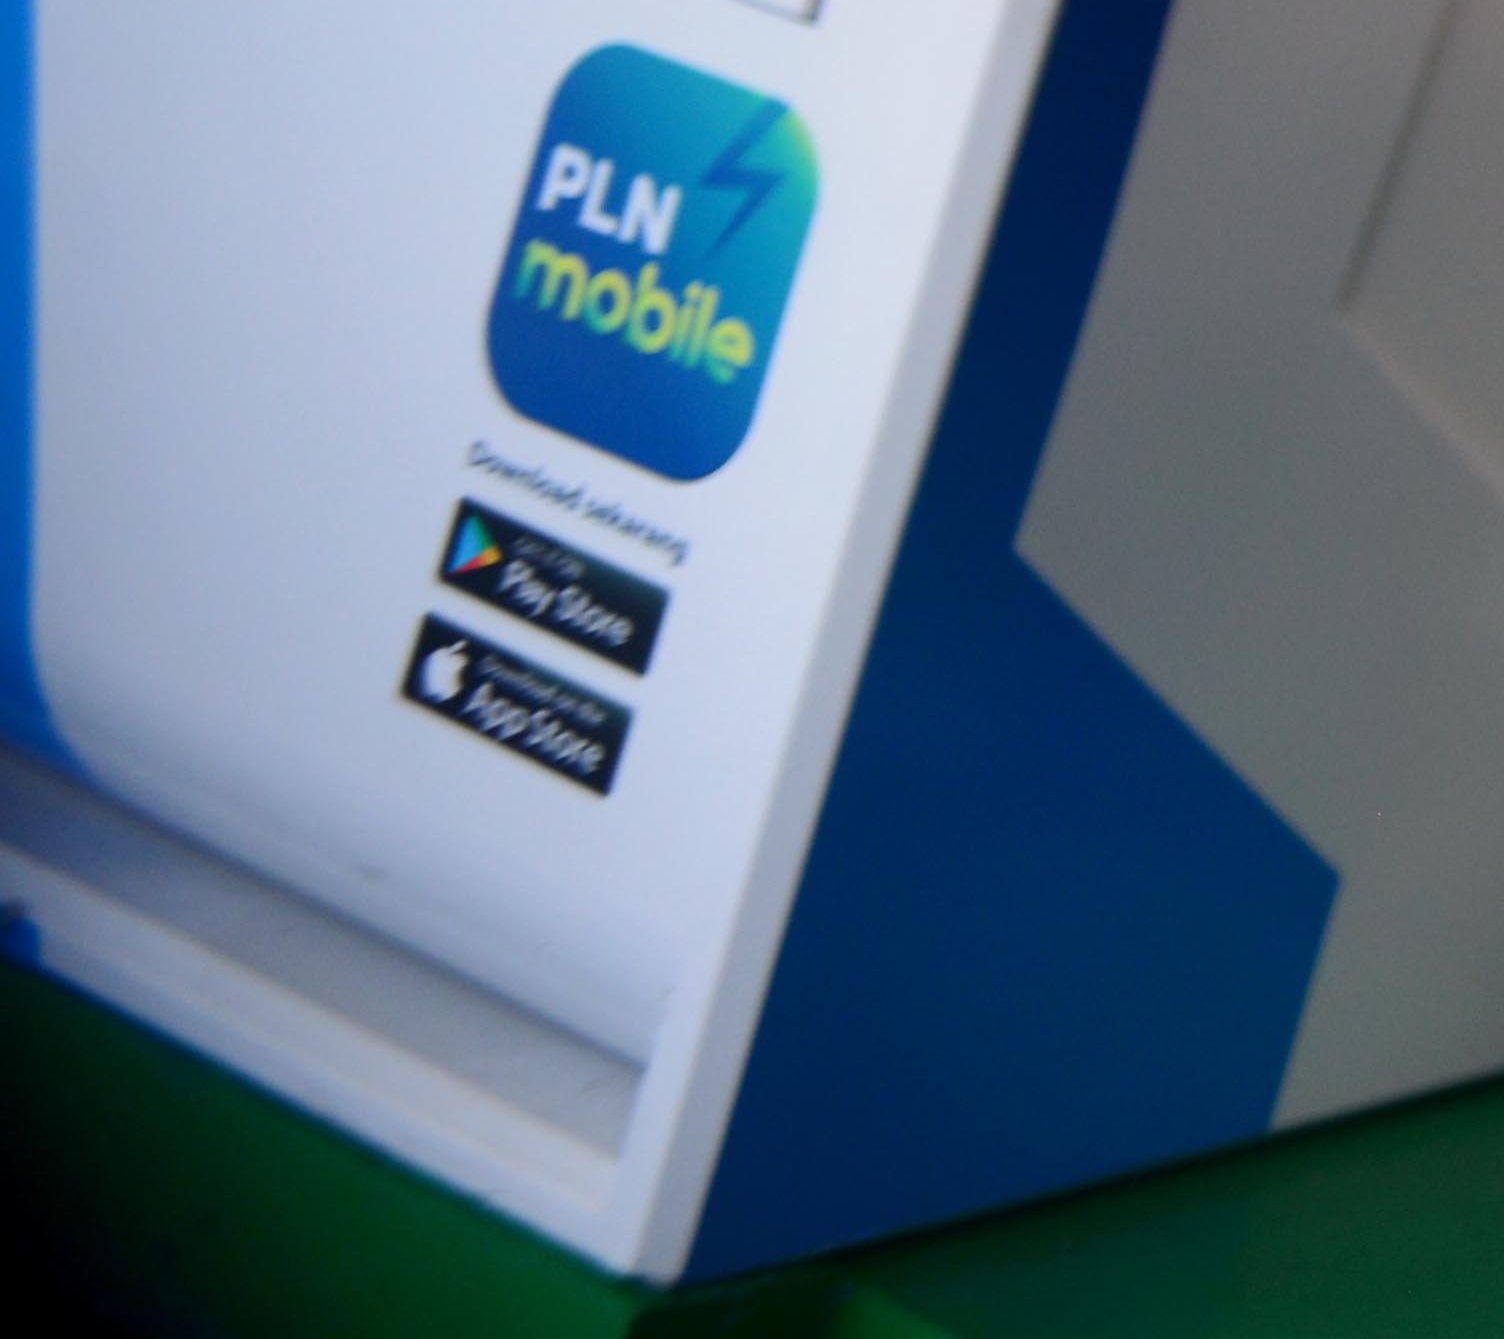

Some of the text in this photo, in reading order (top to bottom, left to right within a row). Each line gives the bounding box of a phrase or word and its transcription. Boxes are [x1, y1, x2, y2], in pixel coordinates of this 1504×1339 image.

[535, 141, 684, 256] PLN
[512, 237, 756, 385] mobile
[498, 558, 557, 619] Play
[462, 680, 528, 743] App
